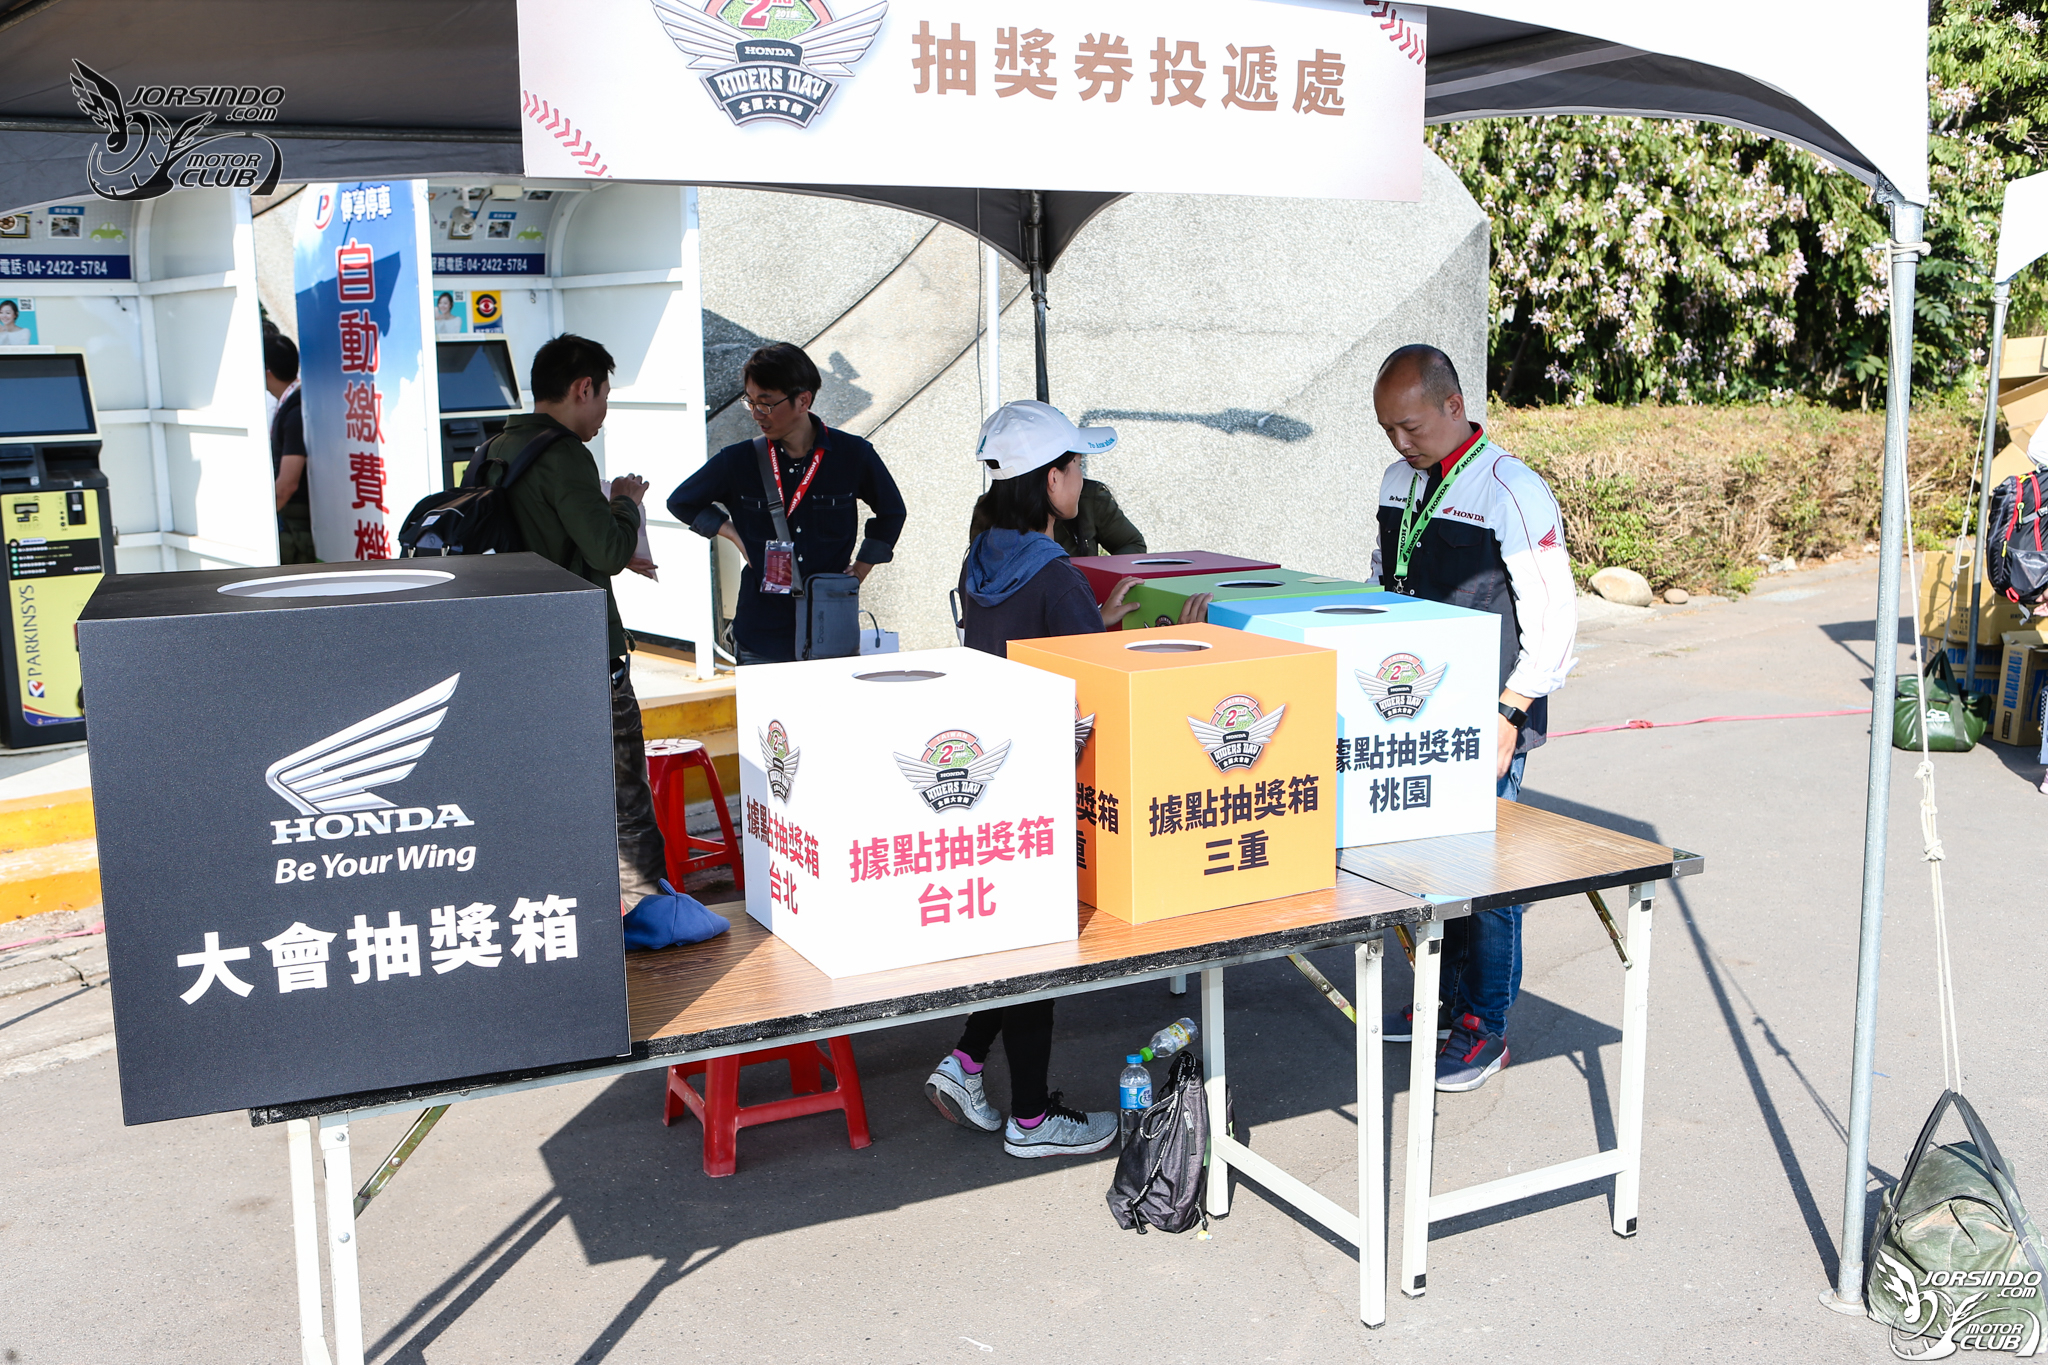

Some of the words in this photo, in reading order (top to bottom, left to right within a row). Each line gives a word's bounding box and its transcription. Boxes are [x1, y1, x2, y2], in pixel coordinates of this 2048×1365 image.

[744, 46, 795, 57] HONDA
[911, 20, 1346, 117] 抽獎券投遞處
[714, 67, 783, 98] RIDERS
[788, 69, 827, 100] DAY
[336, 239, 392, 560] 自動繳費機
[801, 461, 817, 486] HONDA
[1461, 442, 1485, 469] HONDA
[1428, 483, 1450, 513] HONDA
[1453, 509, 1485, 523] HONDA
[1406, 528, 1422, 554] HONDA
[19, 585, 43, 677] PARKINSYS
[1222, 697, 1250, 706] TAIWAN
[936, 732, 968, 742] TAIWAN
[939, 744, 965, 764] 2nd
[1213, 743, 1241, 761] RIDERS
[1243, 743, 1259, 755] DAY
[926, 782, 960, 800] RIDERS
[961, 782, 981, 795] DAY
[1149, 774, 1319, 838] 據點抽獎箱
[1369, 774, 1432, 814] 桃園
[270, 804, 475, 845] HONDA
[746, 795, 820, 879] 據點抽獎箱
[275, 858, 317, 884] Be
[321, 853, 393, 879] Your
[397, 844, 477, 872] Wing
[849, 815, 1055, 883] 據點抽獎箱
[1203, 830, 1270, 877] 三重
[769, 860, 798, 915] 台北
[917, 877, 997, 927] 台北
[176, 894, 579, 1005] 大會抽獎箱
